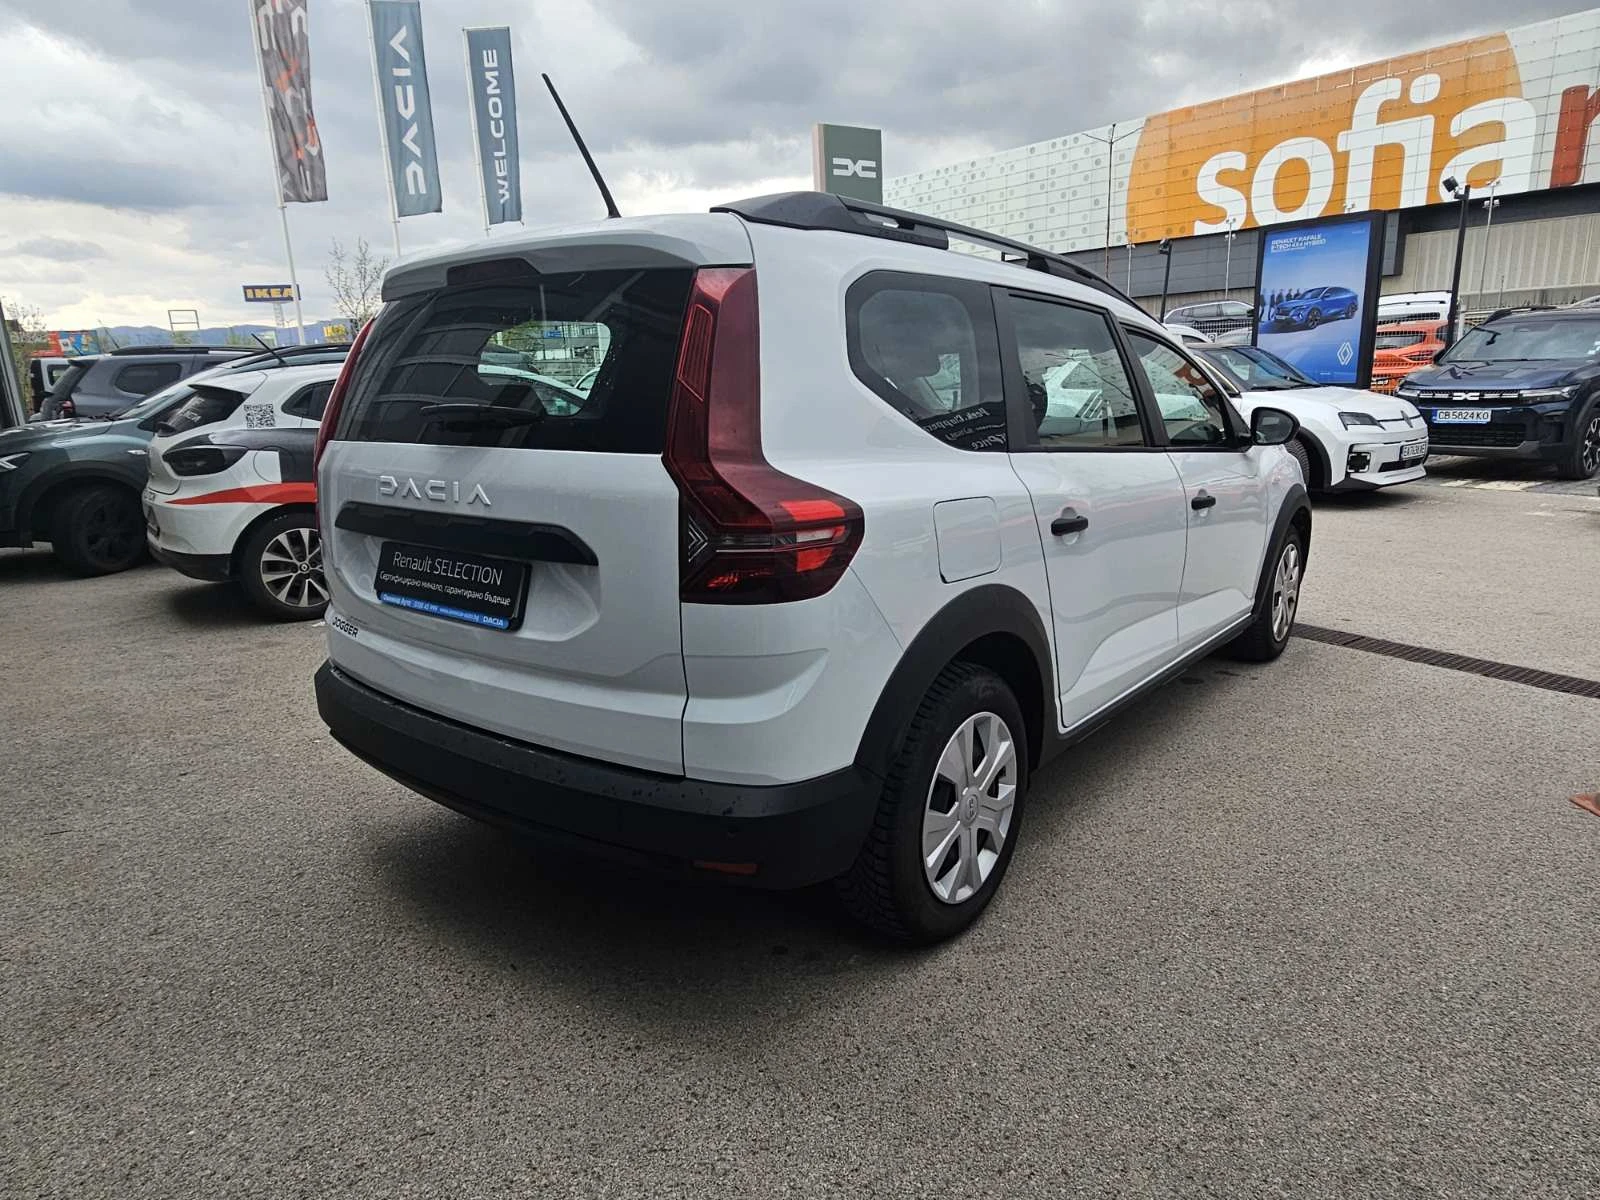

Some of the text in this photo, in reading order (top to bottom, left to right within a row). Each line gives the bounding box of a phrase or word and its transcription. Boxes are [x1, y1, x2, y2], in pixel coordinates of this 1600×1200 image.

[389, 25, 426, 195] DACIA
[483, 48, 510, 203] WELCOME
[379, 475, 492, 506] DACIA
[393, 551, 503, 585] Renault SELECTION
[444, 584, 484, 599] гарантирано
[484, 591, 511, 606] бъдеще
[332, 616, 359, 639] JOGGER
[483, 614, 504, 627] DACIA
